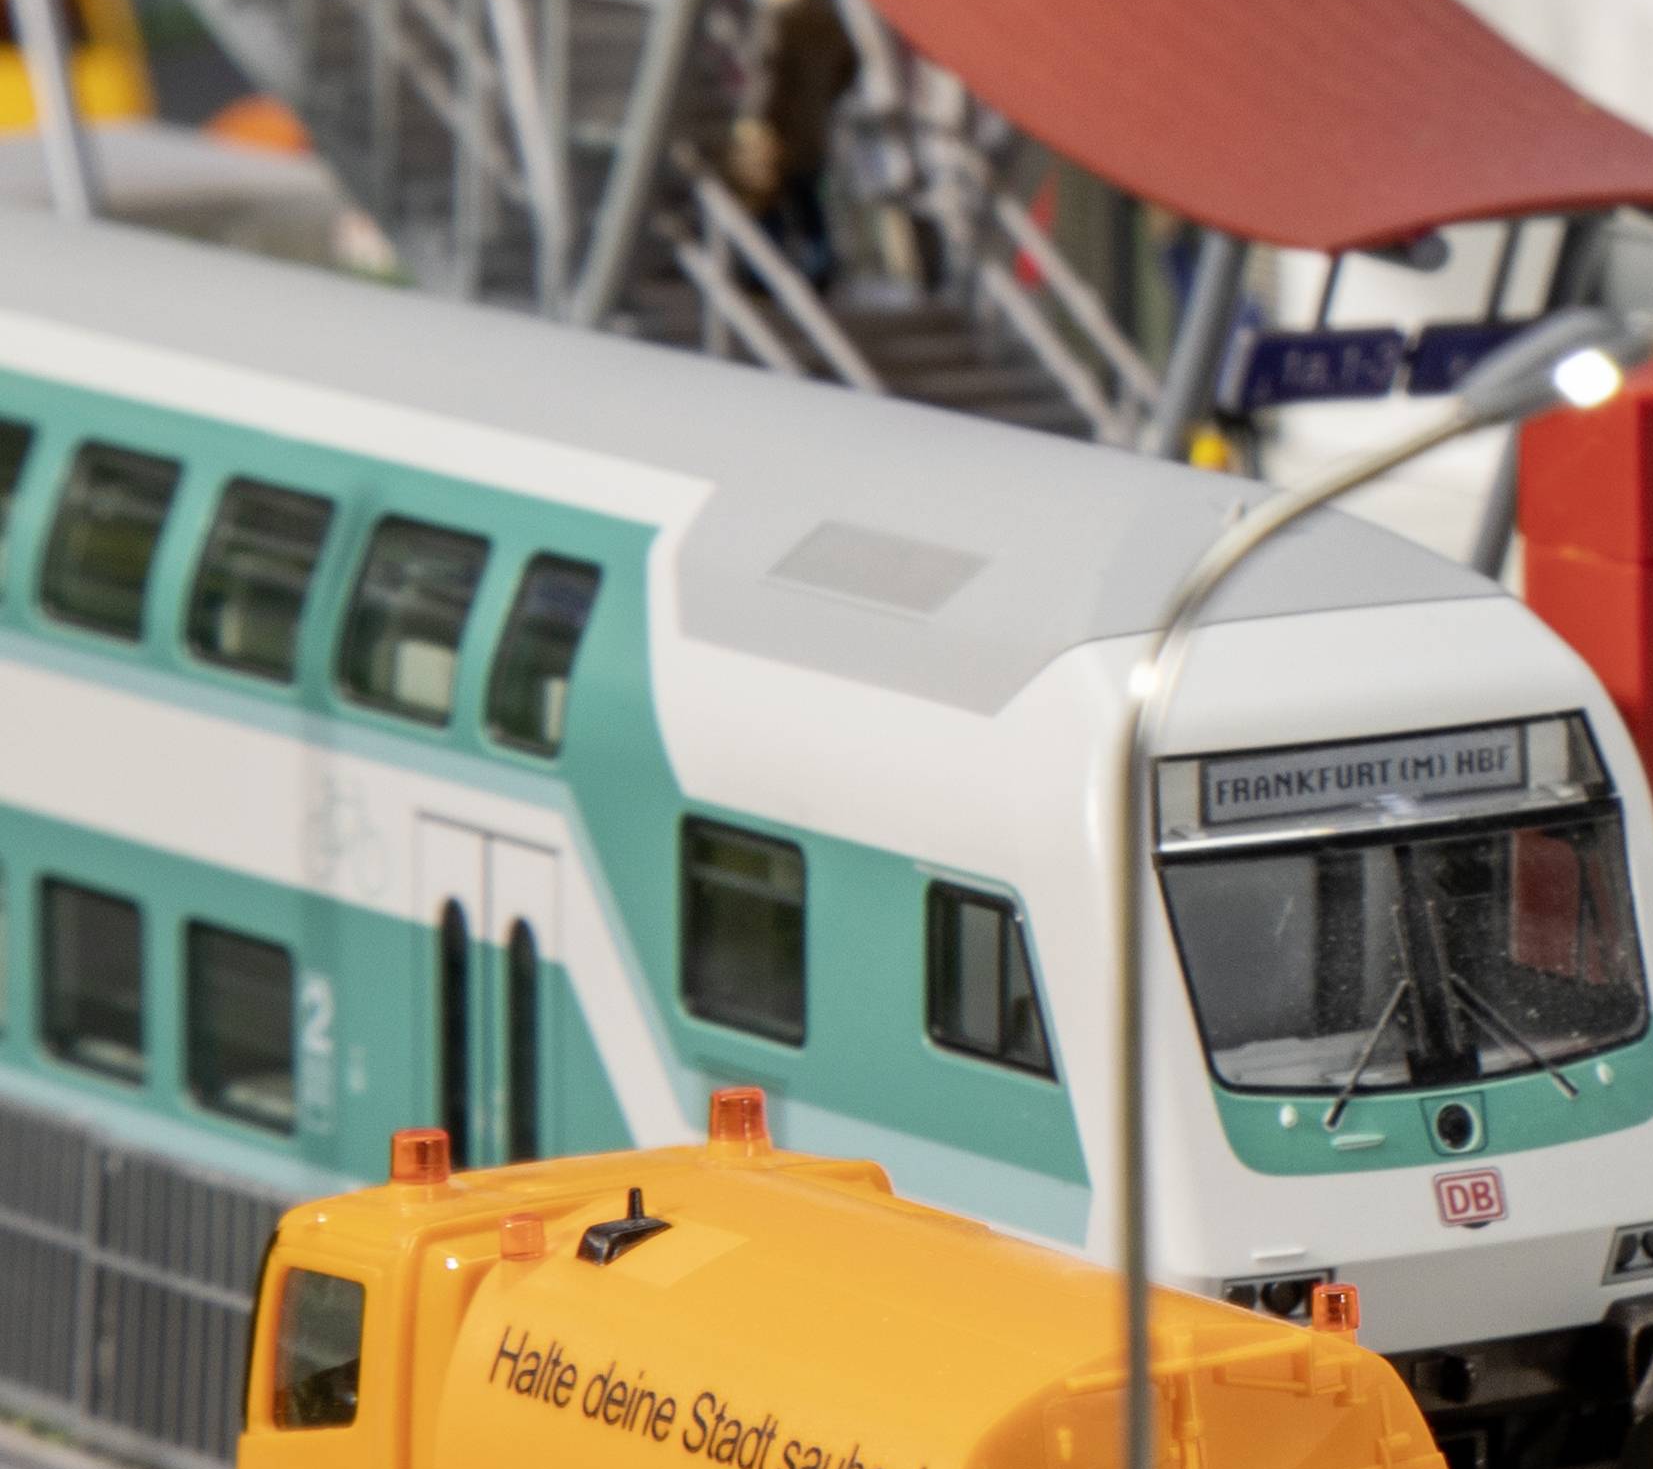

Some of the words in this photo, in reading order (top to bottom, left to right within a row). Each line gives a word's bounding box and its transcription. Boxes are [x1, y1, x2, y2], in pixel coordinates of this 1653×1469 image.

[1215, 757, 1394, 806] FRANKFURT
[1399, 753, 1446, 781] (M)
[1455, 743, 1512, 776] HBF
[300, 975, 335, 1053] 2
[1446, 1181, 1494, 1215] DB
[489, 1325, 578, 1409] Halte
[582, 1360, 677, 1442] deine
